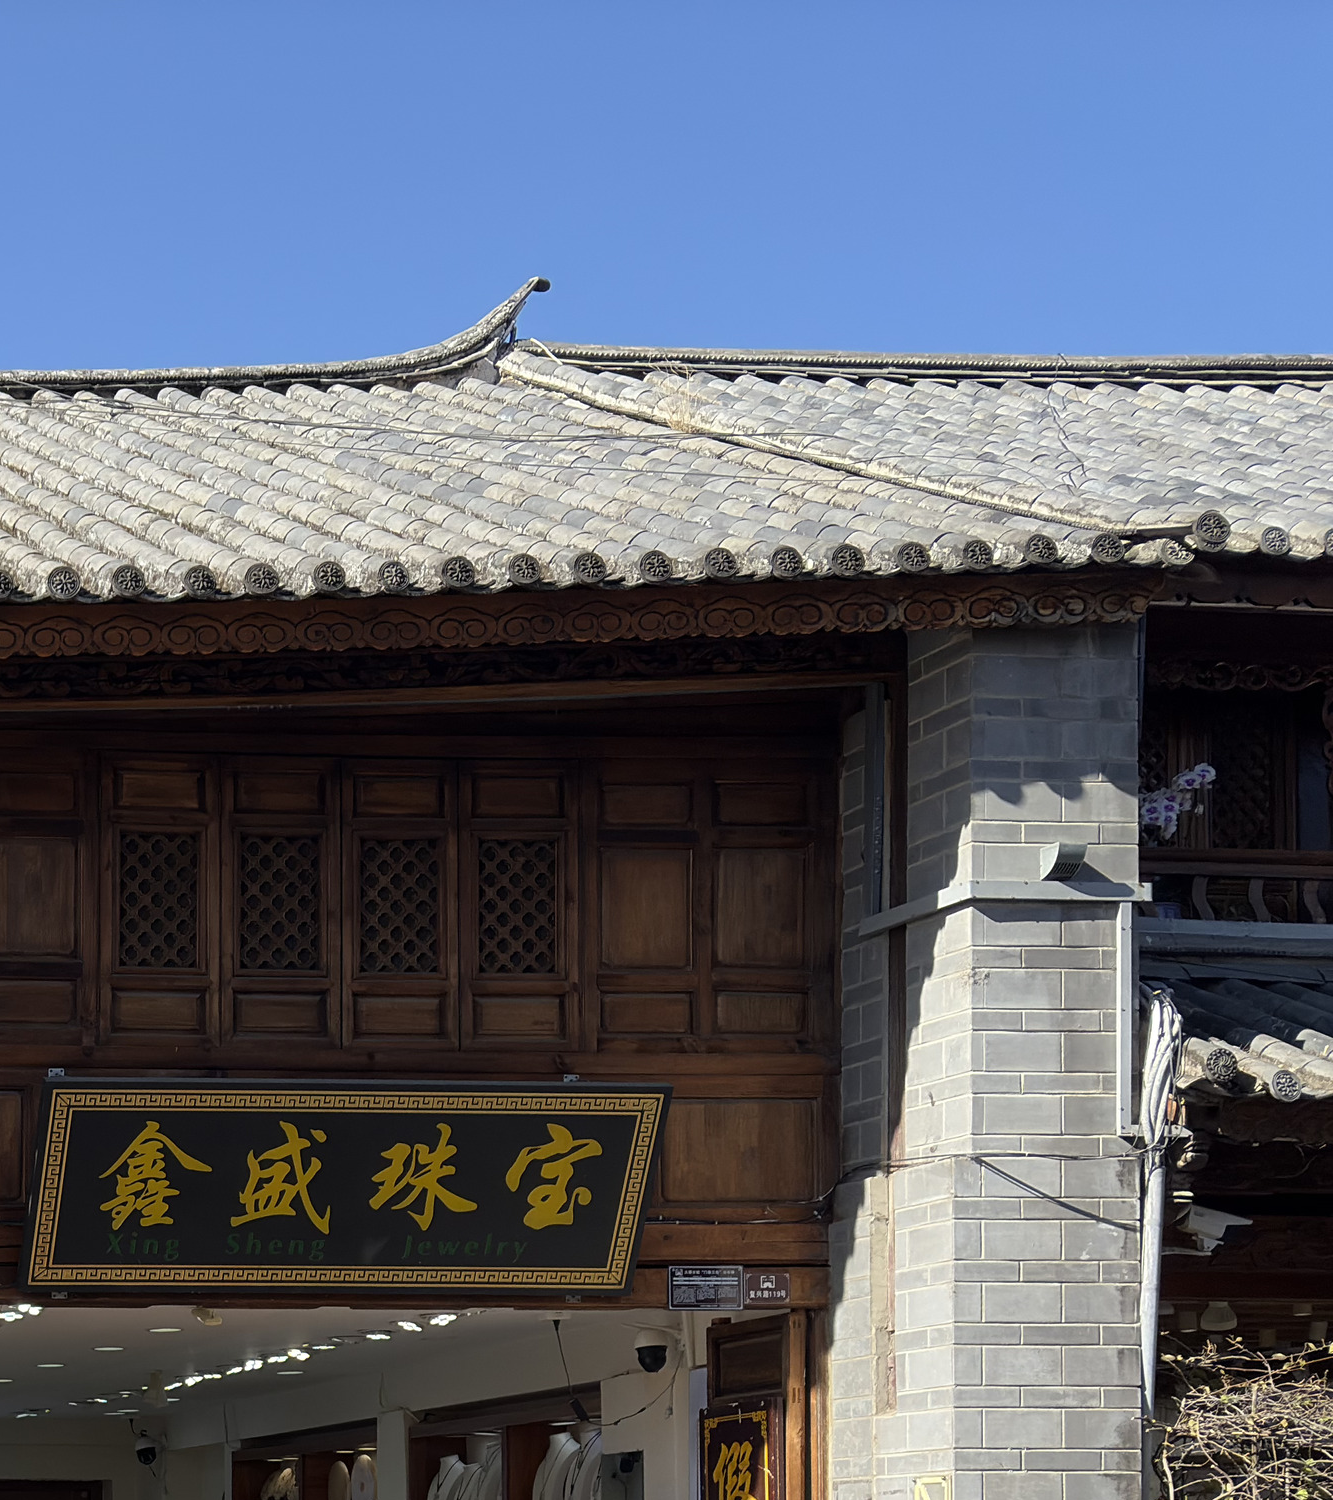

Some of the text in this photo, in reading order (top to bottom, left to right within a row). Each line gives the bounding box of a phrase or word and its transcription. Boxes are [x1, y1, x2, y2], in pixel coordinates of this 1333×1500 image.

[99, 1120, 604, 1235] 鑫盛珠宝
[105, 1231, 529, 1260] Xing Sheng Jewelry
[749, 1290, 787, 1299] 复兴路119号
